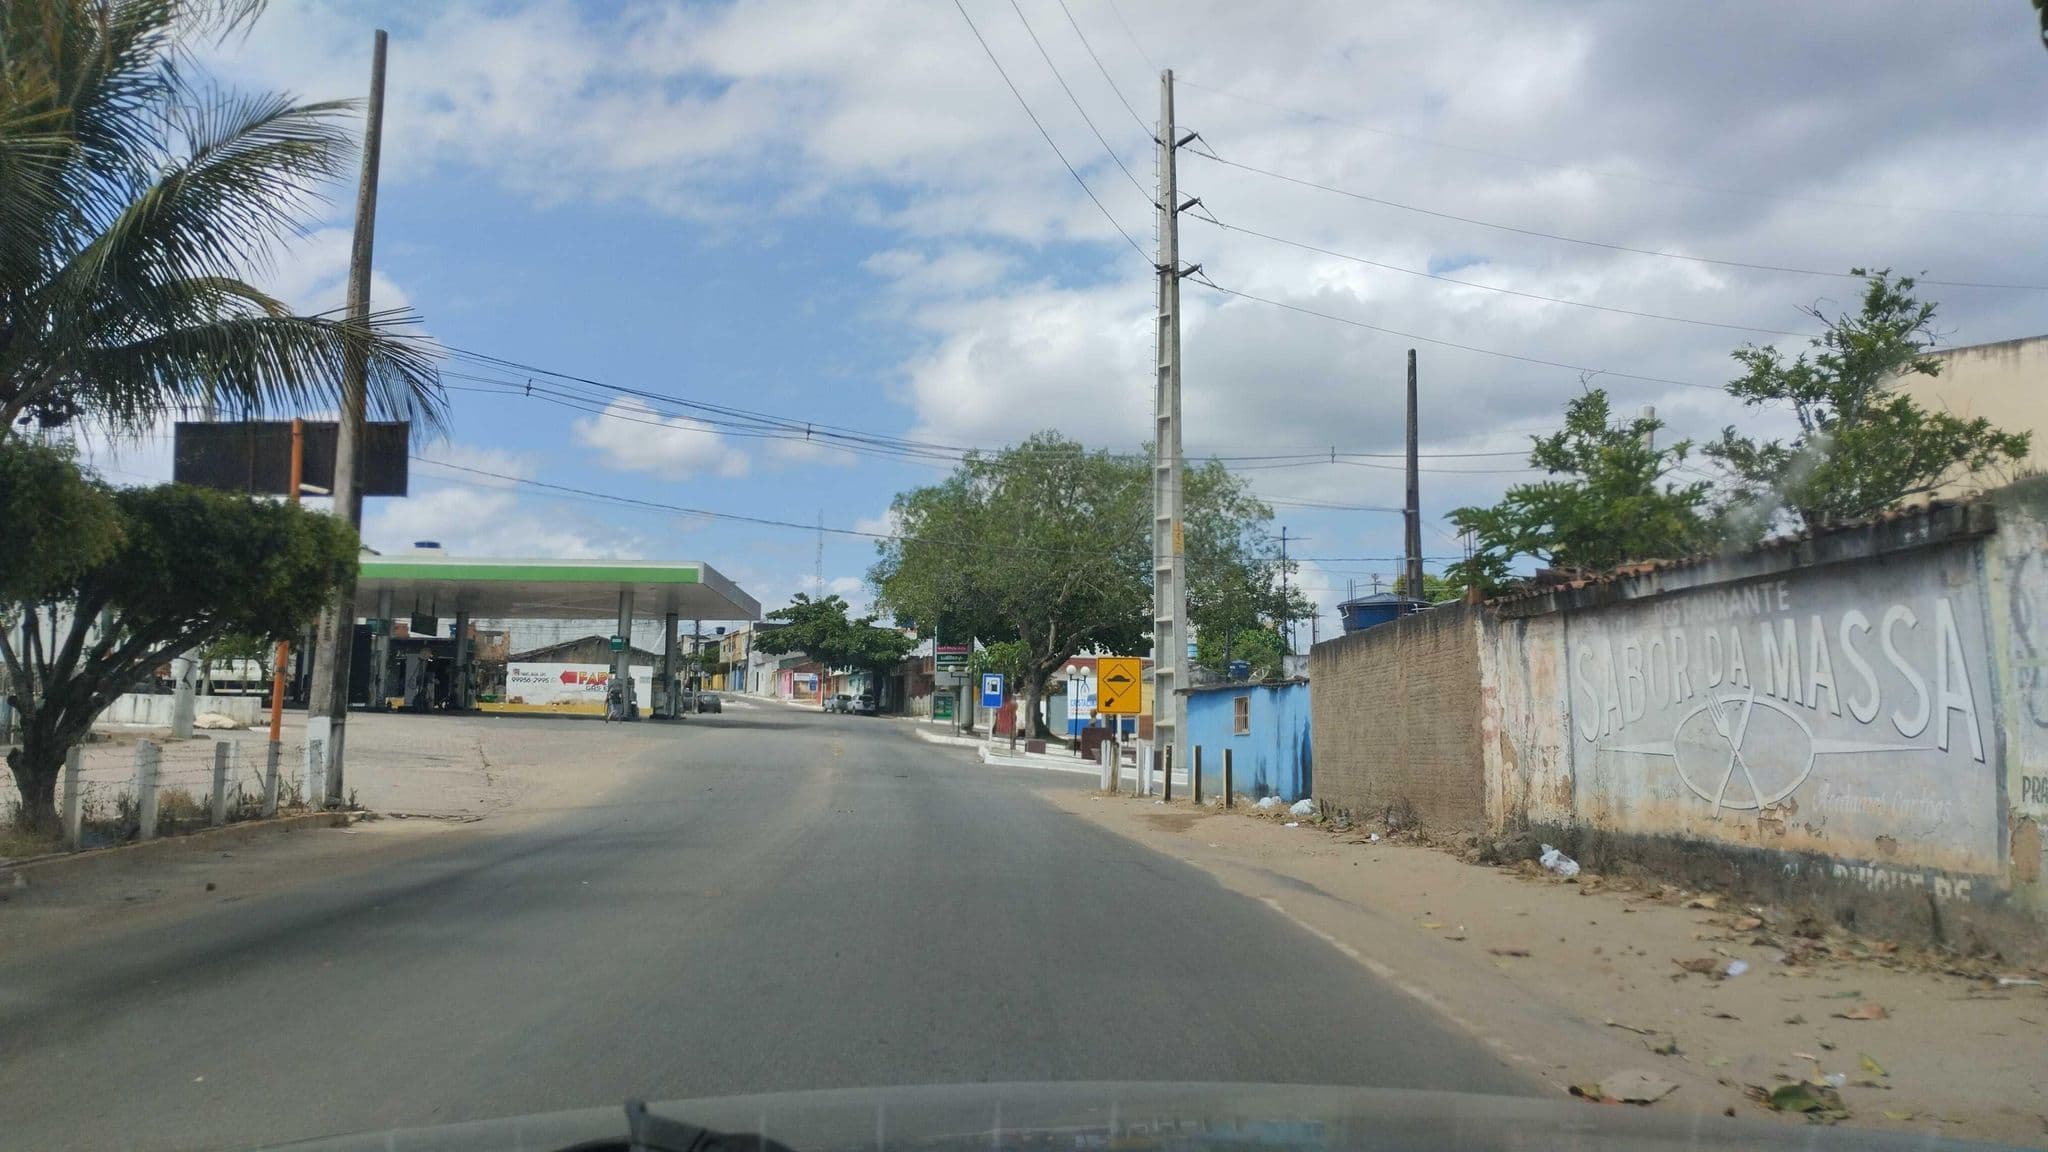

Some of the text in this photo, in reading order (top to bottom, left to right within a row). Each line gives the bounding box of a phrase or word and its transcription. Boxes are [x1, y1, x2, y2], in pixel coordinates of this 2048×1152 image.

[1654, 580, 1791, 627] RESTAURANTE
[1574, 627, 1695, 743] SABOR
[1704, 623, 1751, 690] DA
[1761, 597, 1986, 765] MASSA
